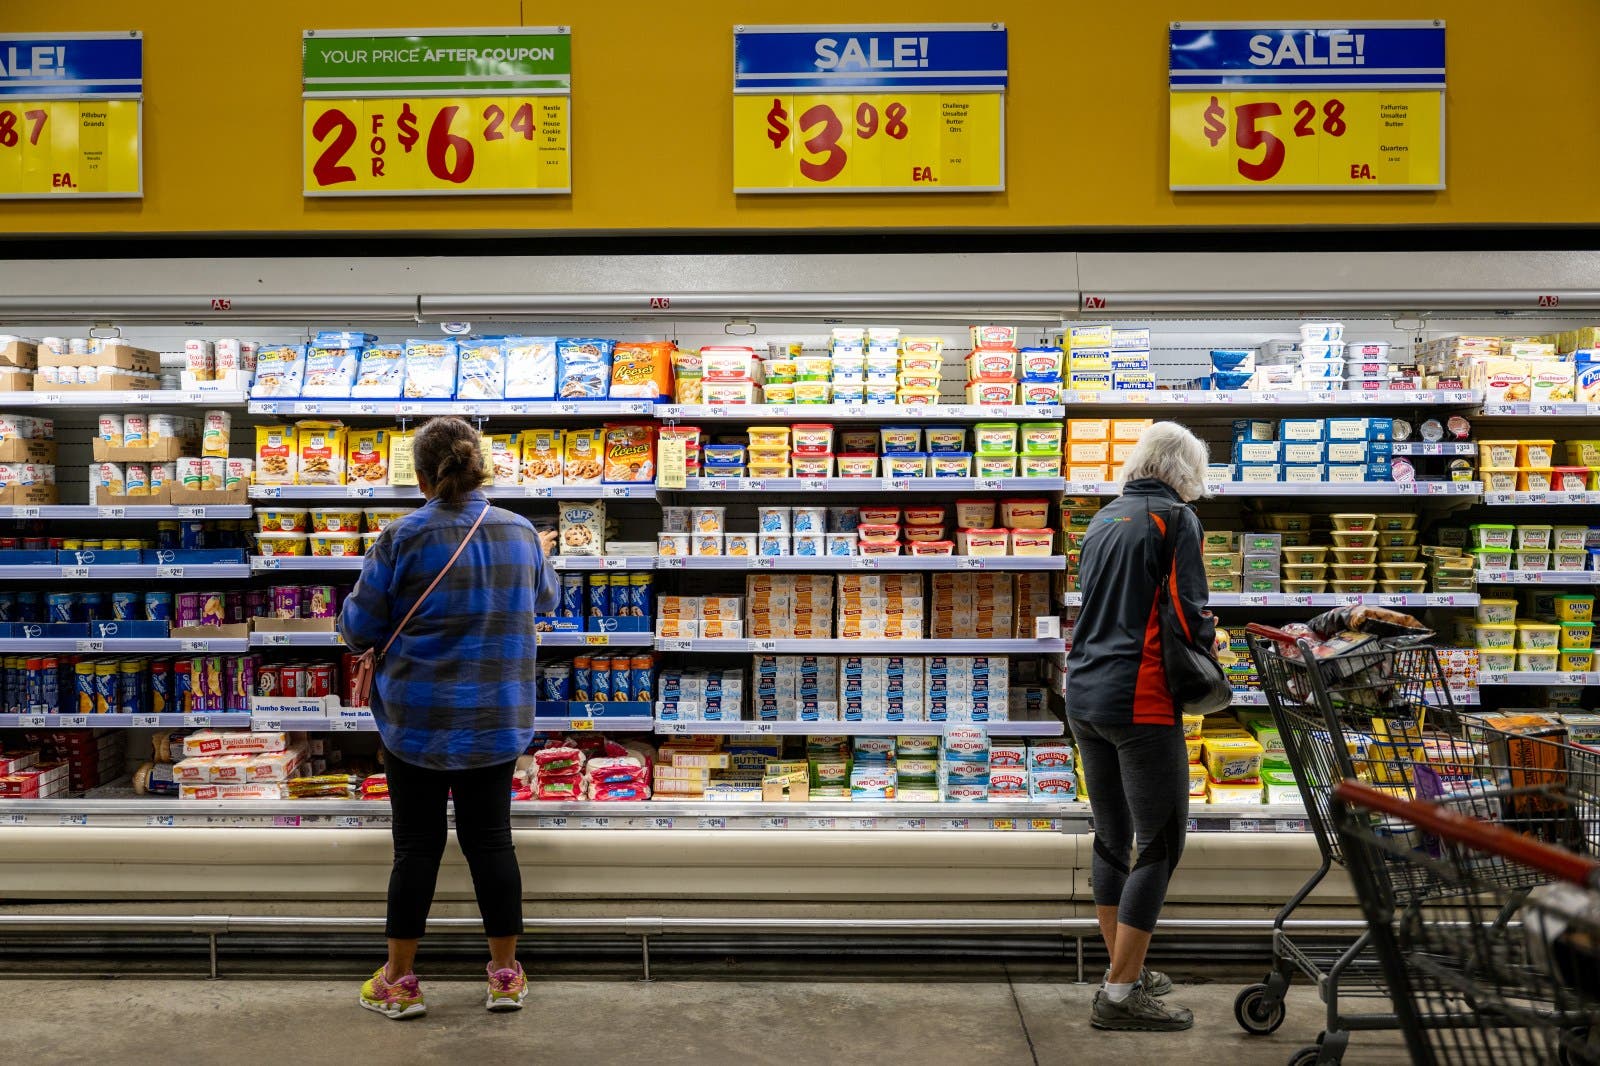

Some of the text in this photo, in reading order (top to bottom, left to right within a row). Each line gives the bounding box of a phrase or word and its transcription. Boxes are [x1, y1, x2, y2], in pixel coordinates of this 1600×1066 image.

[814, 37, 928, 69] SALE!
[1249, 34, 1364, 65] SALE!
[321, 47, 555, 64] YOUR PRICE AFTER COUPON
[312, 109, 357, 186] 2
[370, 114, 386, 177] FOR
[913, 166, 938, 182] EA.
[1350, 164, 1376, 179] EA.
[52, 173, 77, 187] EA.
[212, 300, 231, 310] A5
[651, 298, 670, 308] A6
[1085, 297, 1105, 308] A7
[1539, 296, 1558, 307] A8
[222, 738, 245, 746] English
[1037, 752, 1068, 762] CHALLENGE
[992, 776, 1023, 786] CHALLENGE
[1040, 780, 1071, 789] CHALLENGE
[218, 785, 241, 793] English
